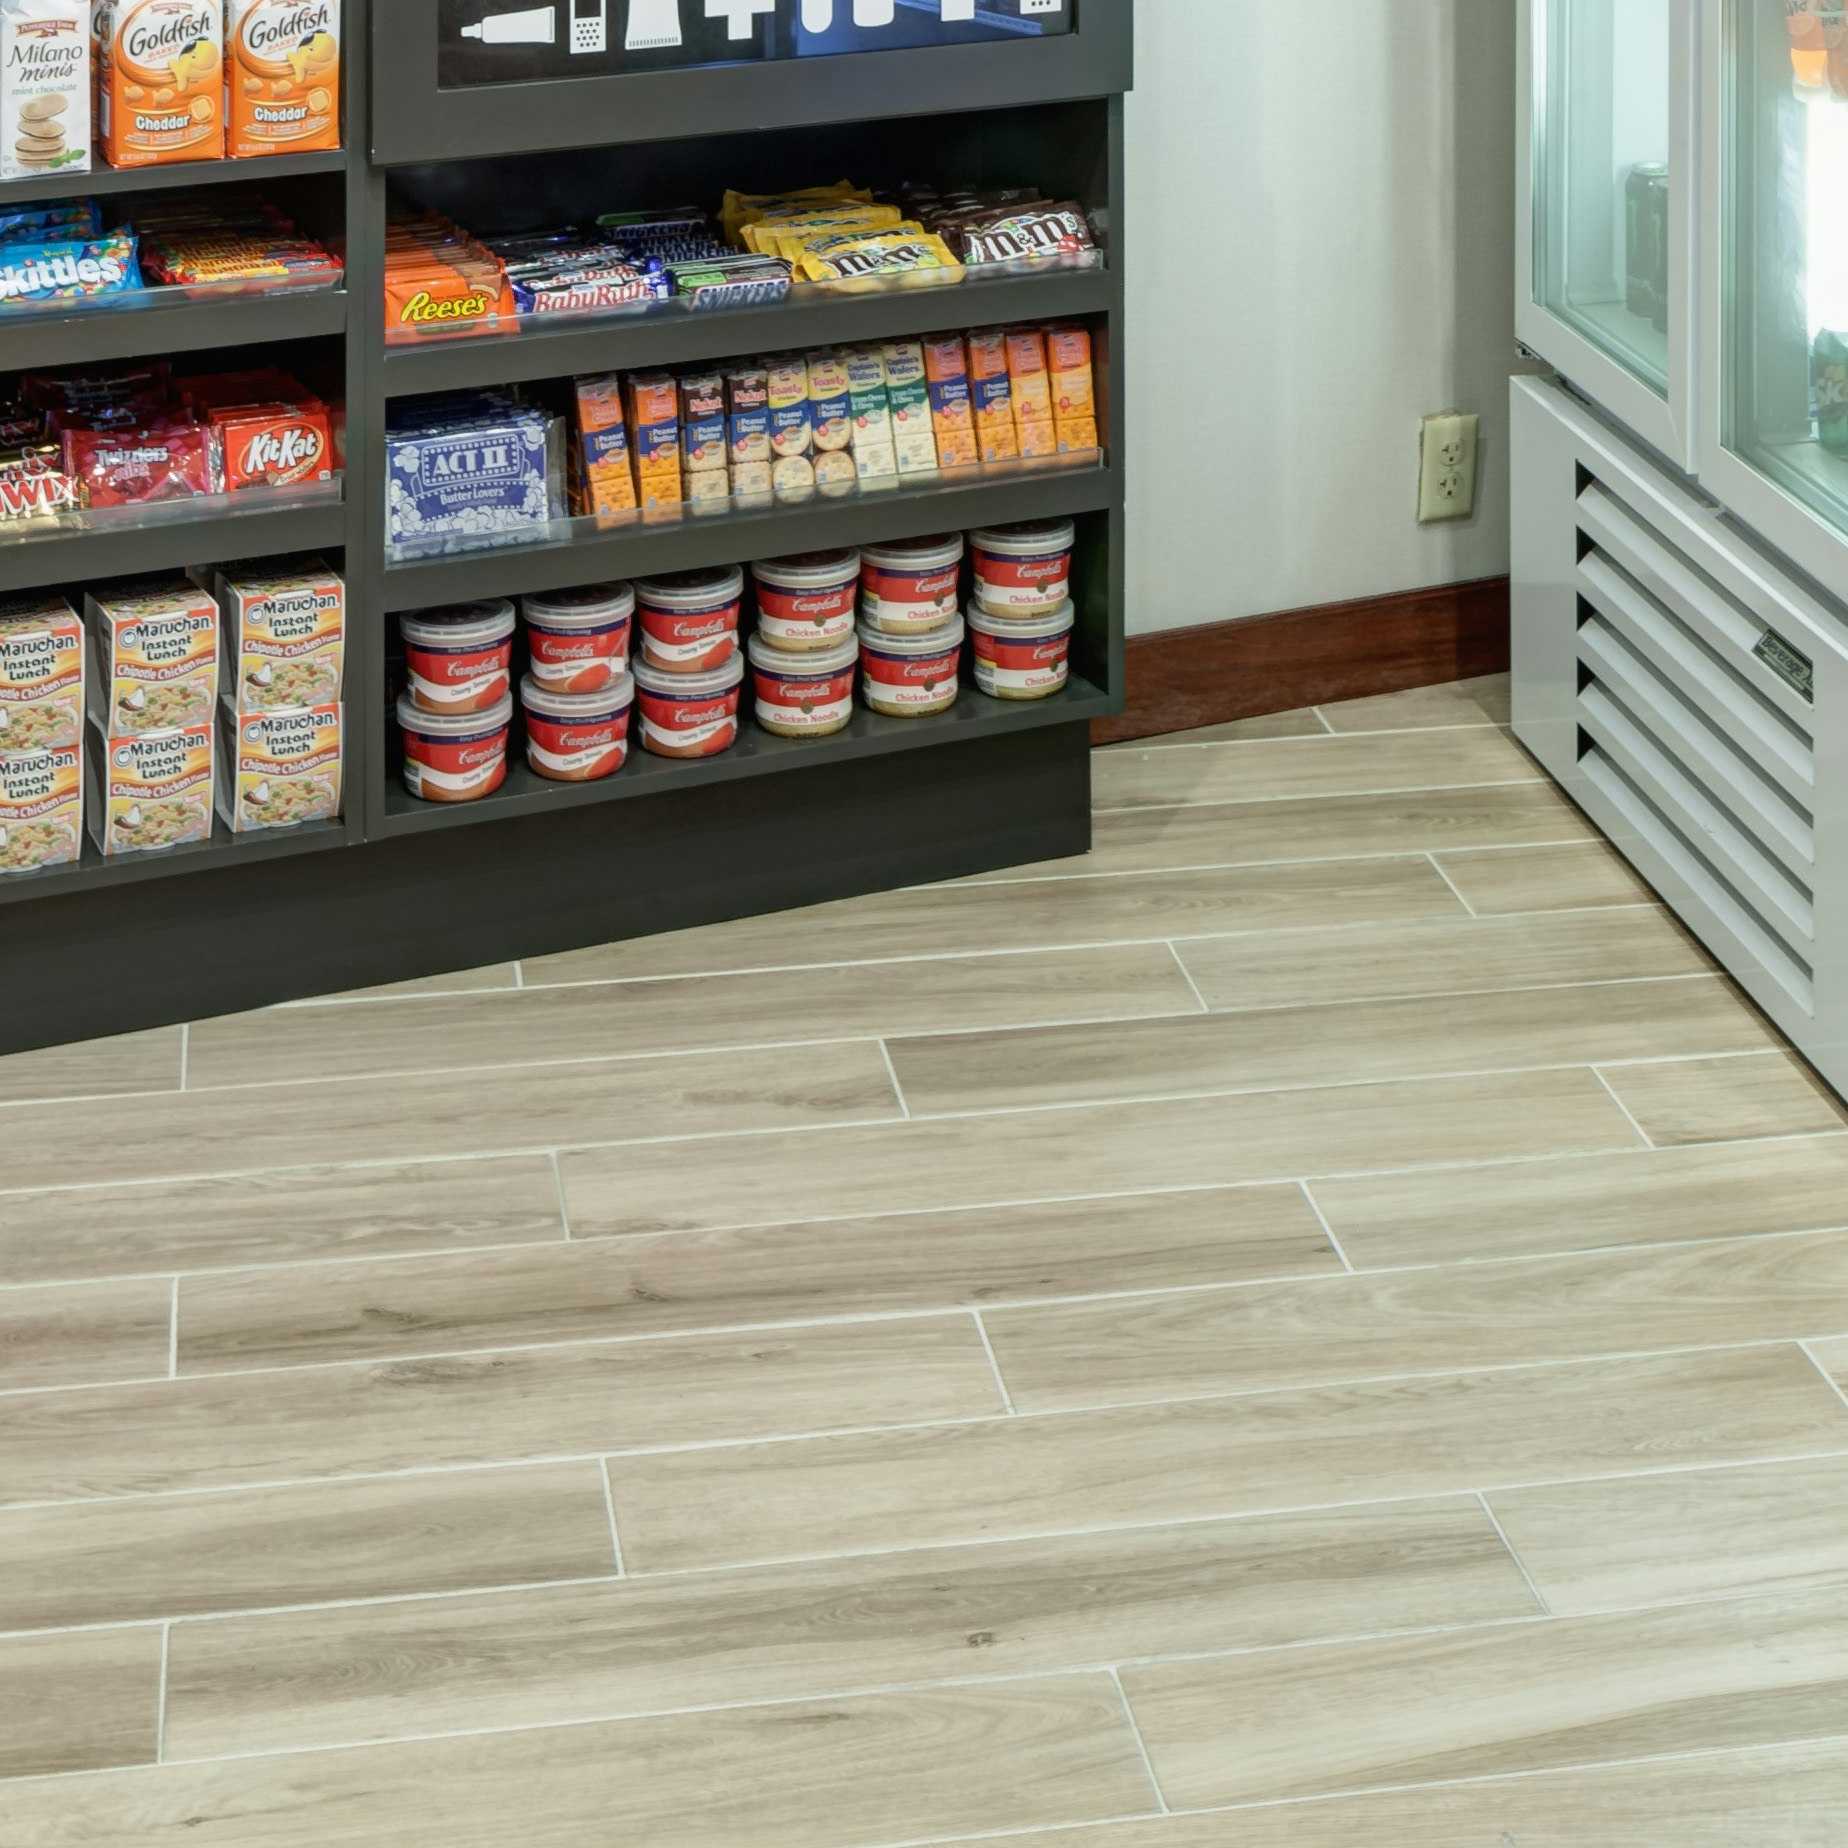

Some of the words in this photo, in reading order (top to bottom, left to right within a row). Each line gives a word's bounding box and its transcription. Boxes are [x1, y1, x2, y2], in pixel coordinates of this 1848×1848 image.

[130, 10, 210, 57] Goldfish
[249, 3, 329, 49] Goldfish
[19, 61, 76, 83] minis
[12, 86, 33, 95] mint
[254, 106, 307, 122] Cheddar
[135, 114, 190, 132] Cheddar
[401, 292, 487, 323] Reese's
[848, 371, 880, 380] Wafers
[888, 365, 919, 375] Wafers
[813, 375, 845, 387] Toasty
[769, 384, 802, 395] Toasty
[433, 450, 479, 477] ACT
[482, 445, 508, 467] II
[440, 490, 471, 505] Butter
[473, 487, 505, 501] Lovers
[786, 627, 821, 637] Chicken
[773, 713, 807, 724] Chicken
